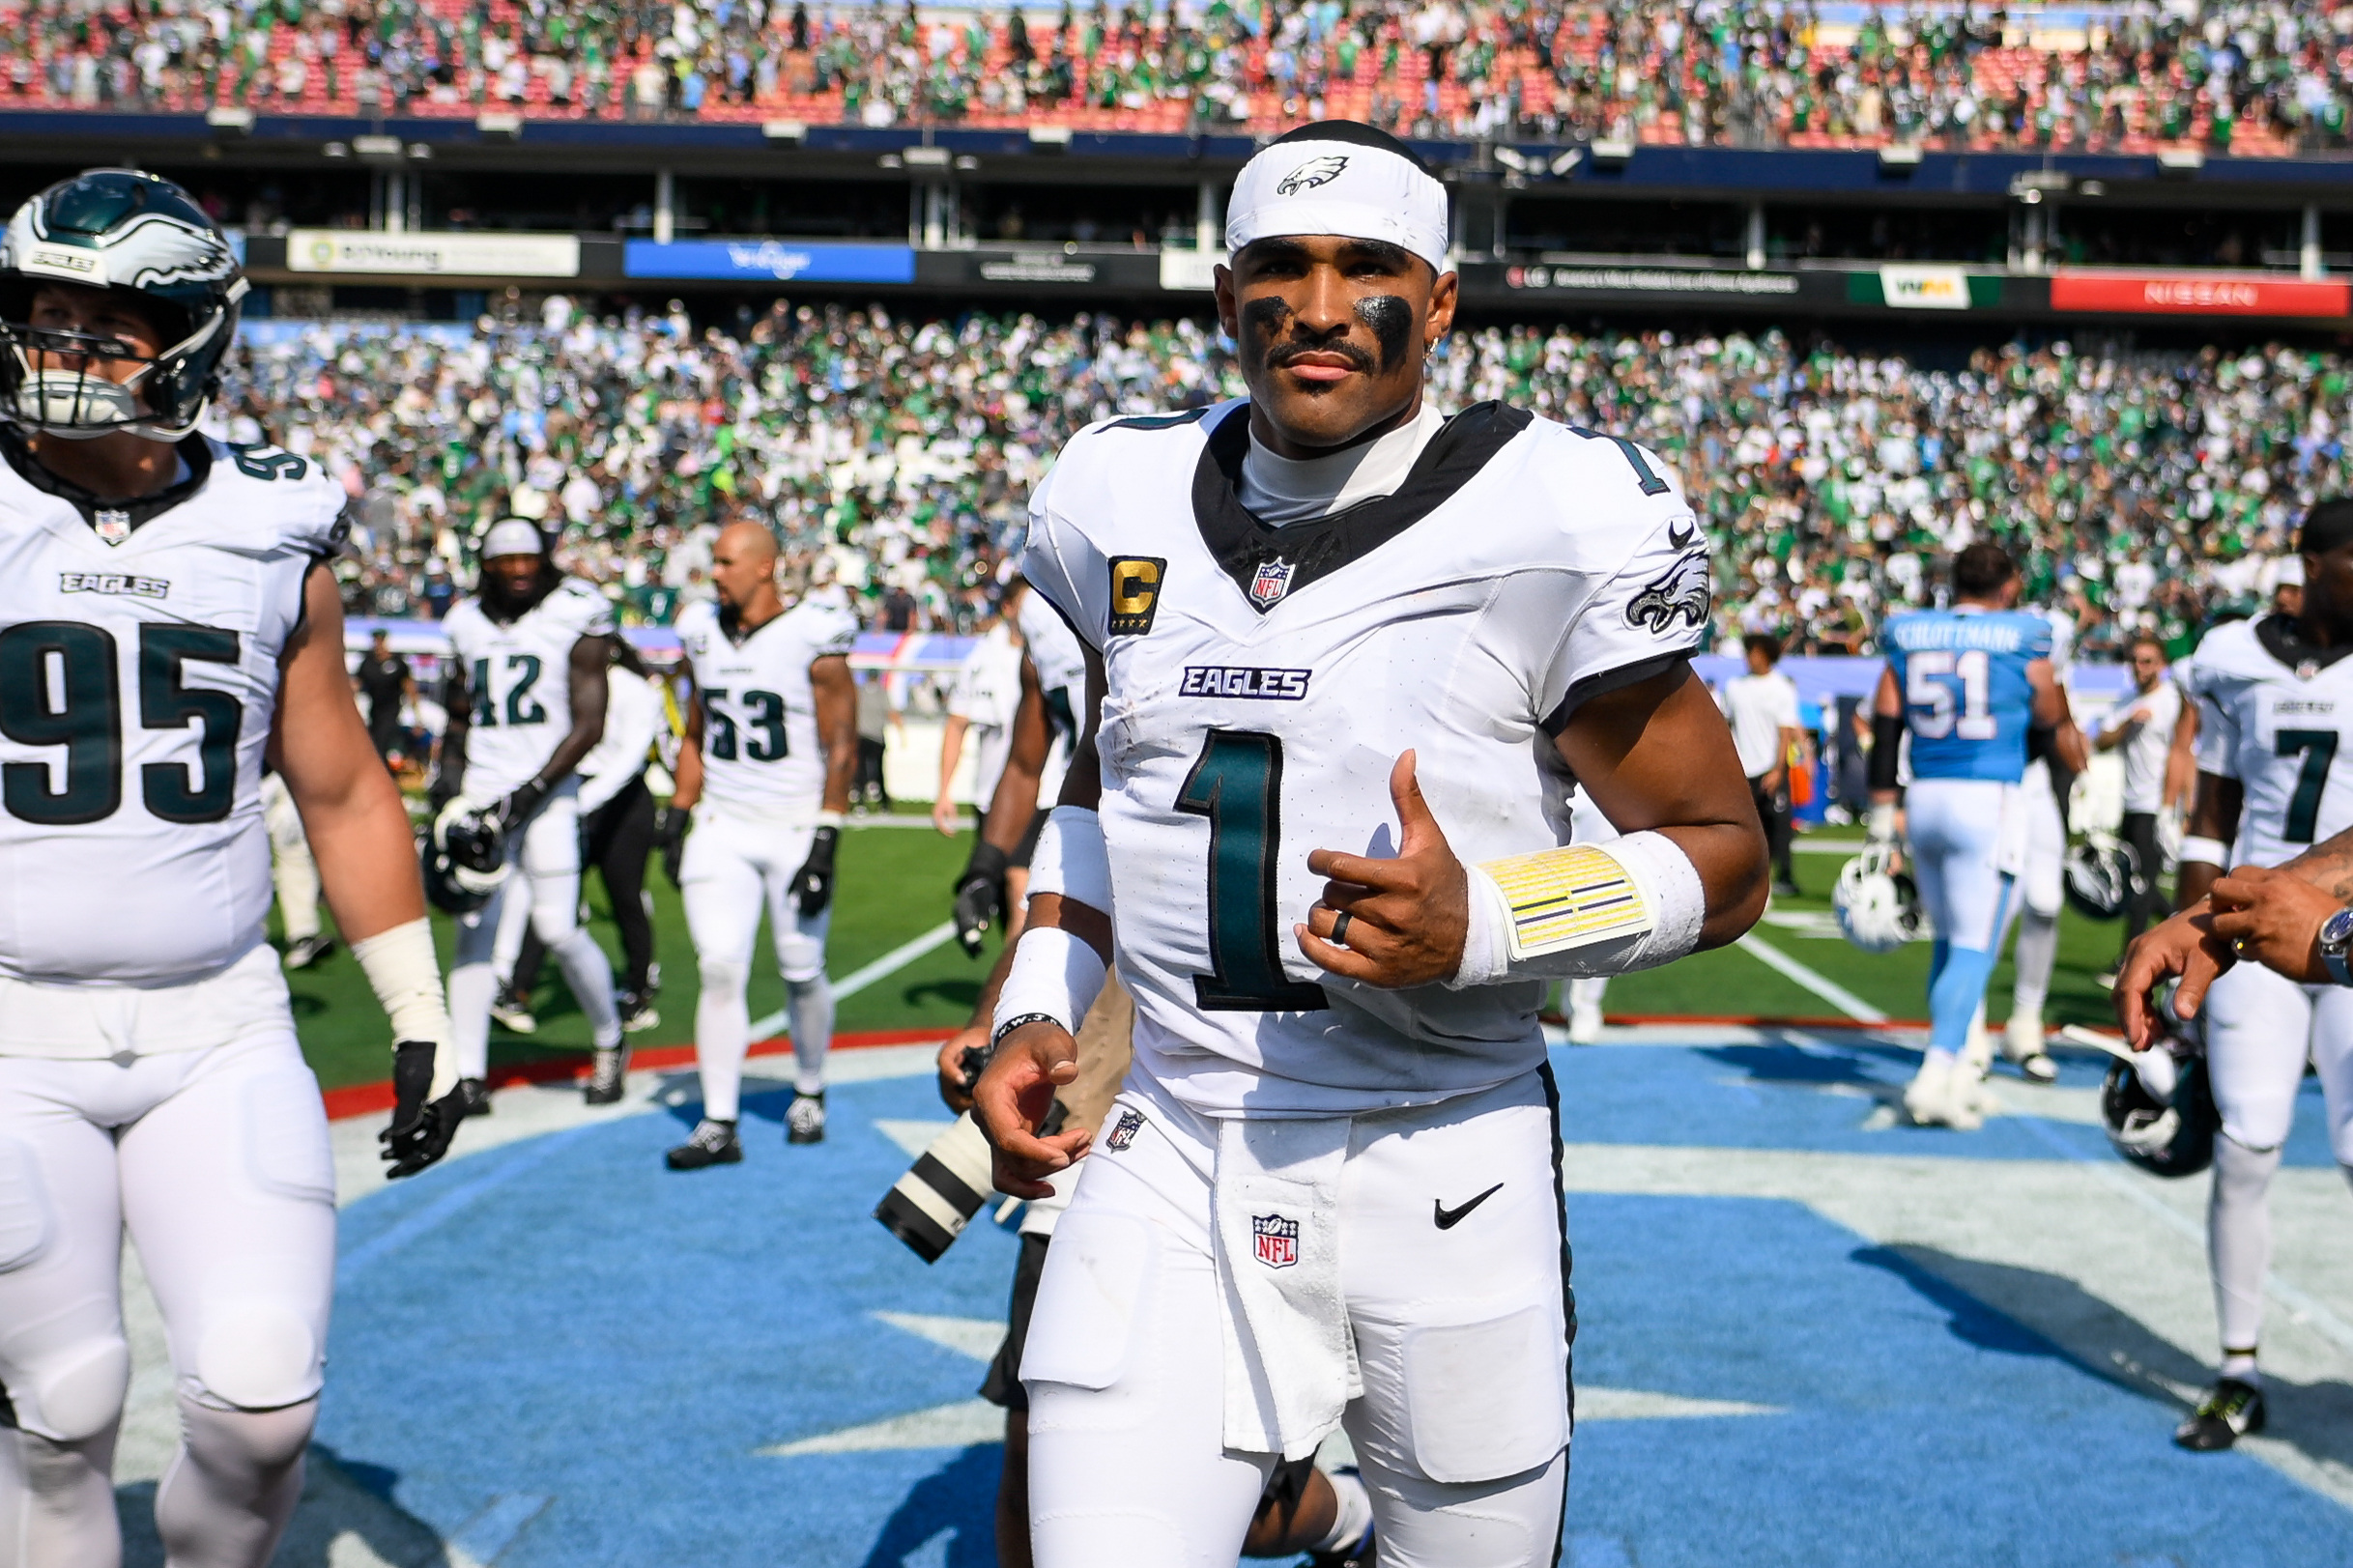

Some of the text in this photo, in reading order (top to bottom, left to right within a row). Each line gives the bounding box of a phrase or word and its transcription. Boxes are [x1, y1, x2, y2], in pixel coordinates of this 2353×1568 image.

[2143, 280, 2259, 306] NISSAN
[60, 573, 170, 599] EAGLES
[1113, 560, 1159, 614] C
[1254, 577, 1280, 598] NFL
[1181, 667, 1311, 699] EAGLES
[1907, 649, 1997, 740] 51
[0, 620, 242, 825] 95
[703, 688, 789, 761] 53
[2276, 729, 2339, 843] 7
[1172, 727, 1330, 1012] 1
[1257, 1235, 1295, 1264] NFL
